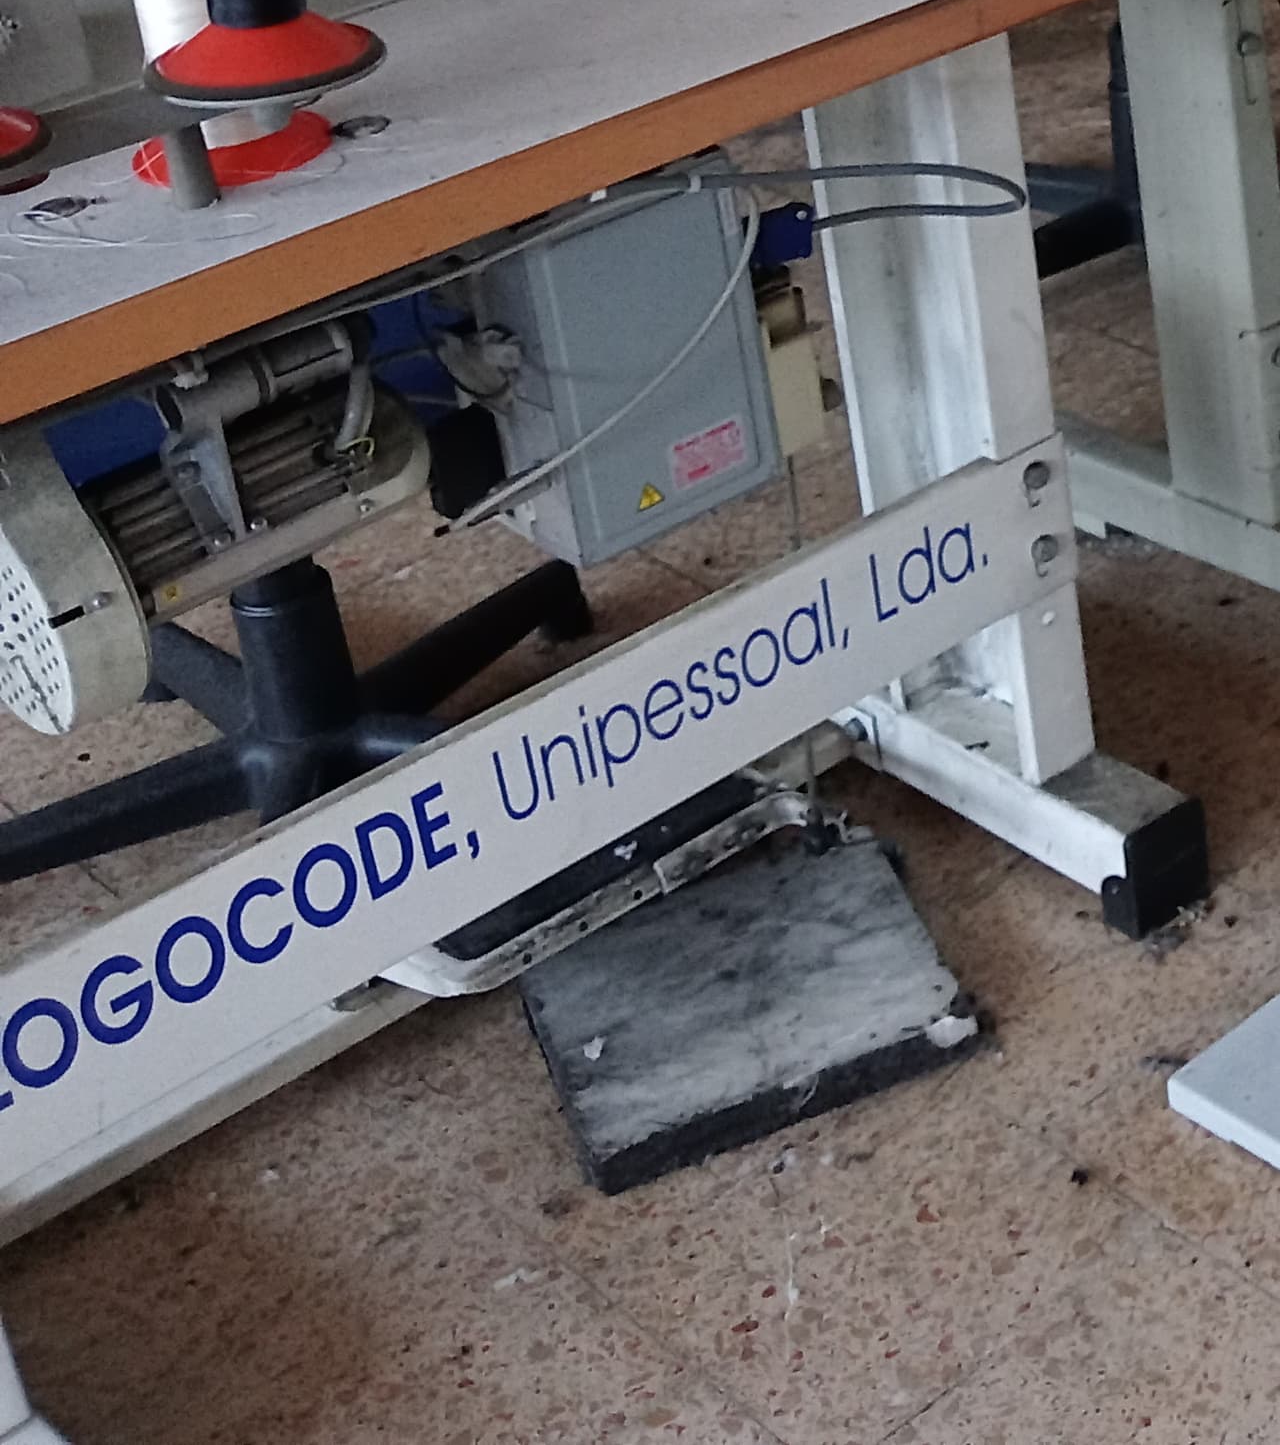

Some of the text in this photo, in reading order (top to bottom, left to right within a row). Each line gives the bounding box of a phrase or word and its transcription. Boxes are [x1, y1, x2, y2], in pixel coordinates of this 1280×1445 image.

[0, 522, 989, 1112] OGOCODE, Unipessoal, Lda.
